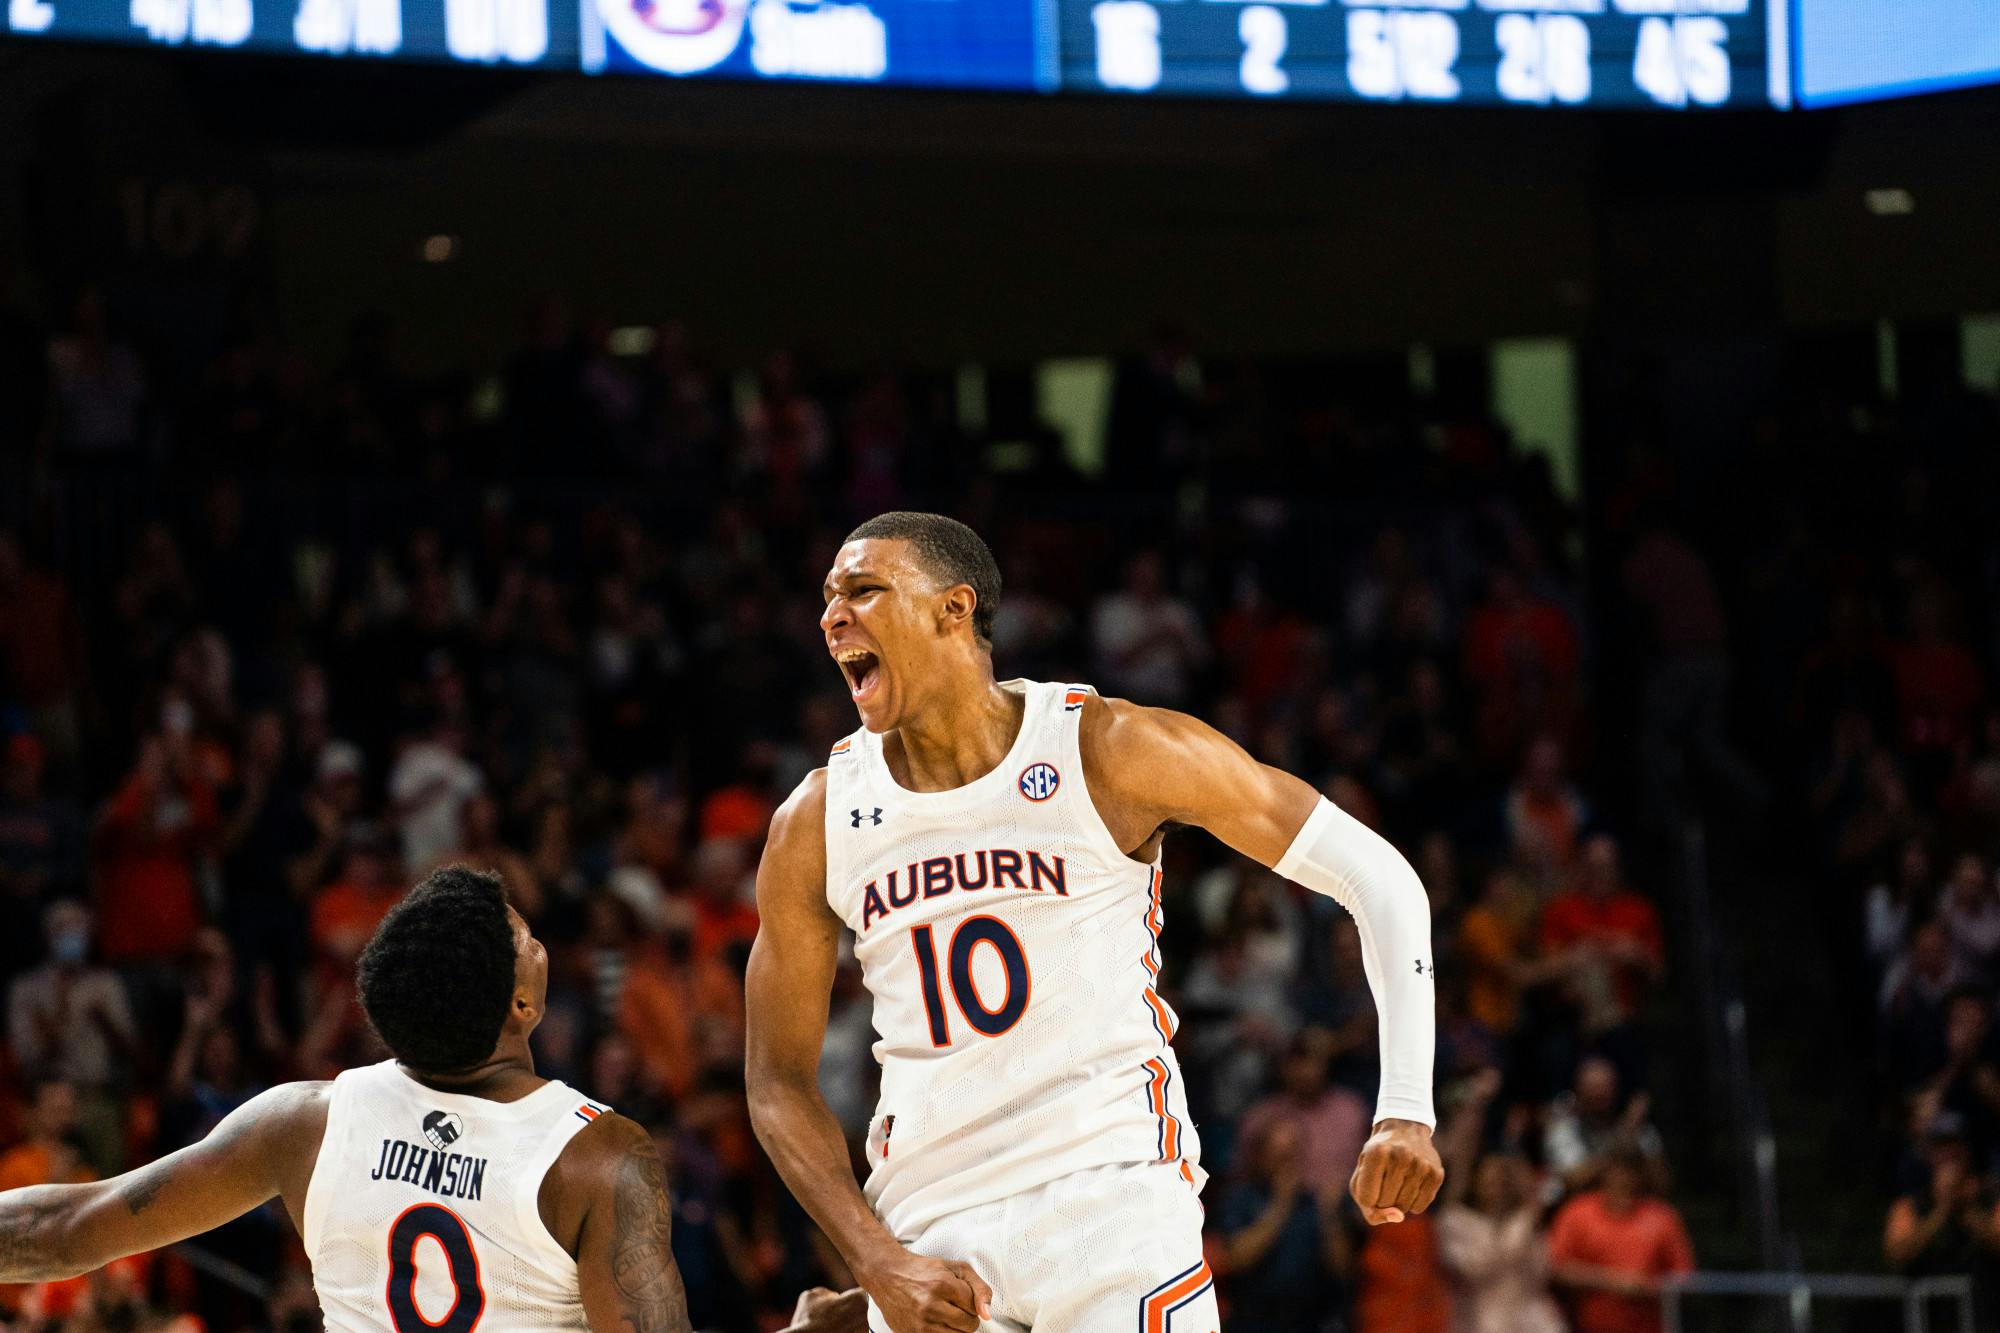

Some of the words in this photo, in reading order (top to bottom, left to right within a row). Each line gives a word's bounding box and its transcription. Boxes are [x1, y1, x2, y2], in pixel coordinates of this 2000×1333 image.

[1240, 5, 1288, 93] 2
[1020, 764, 1059, 800] SEC
[863, 849, 1069, 931] AUBURN
[910, 914, 1032, 1048] 10
[371, 1139, 487, 1201] JOHNSON
[386, 1202, 486, 1333] 0
